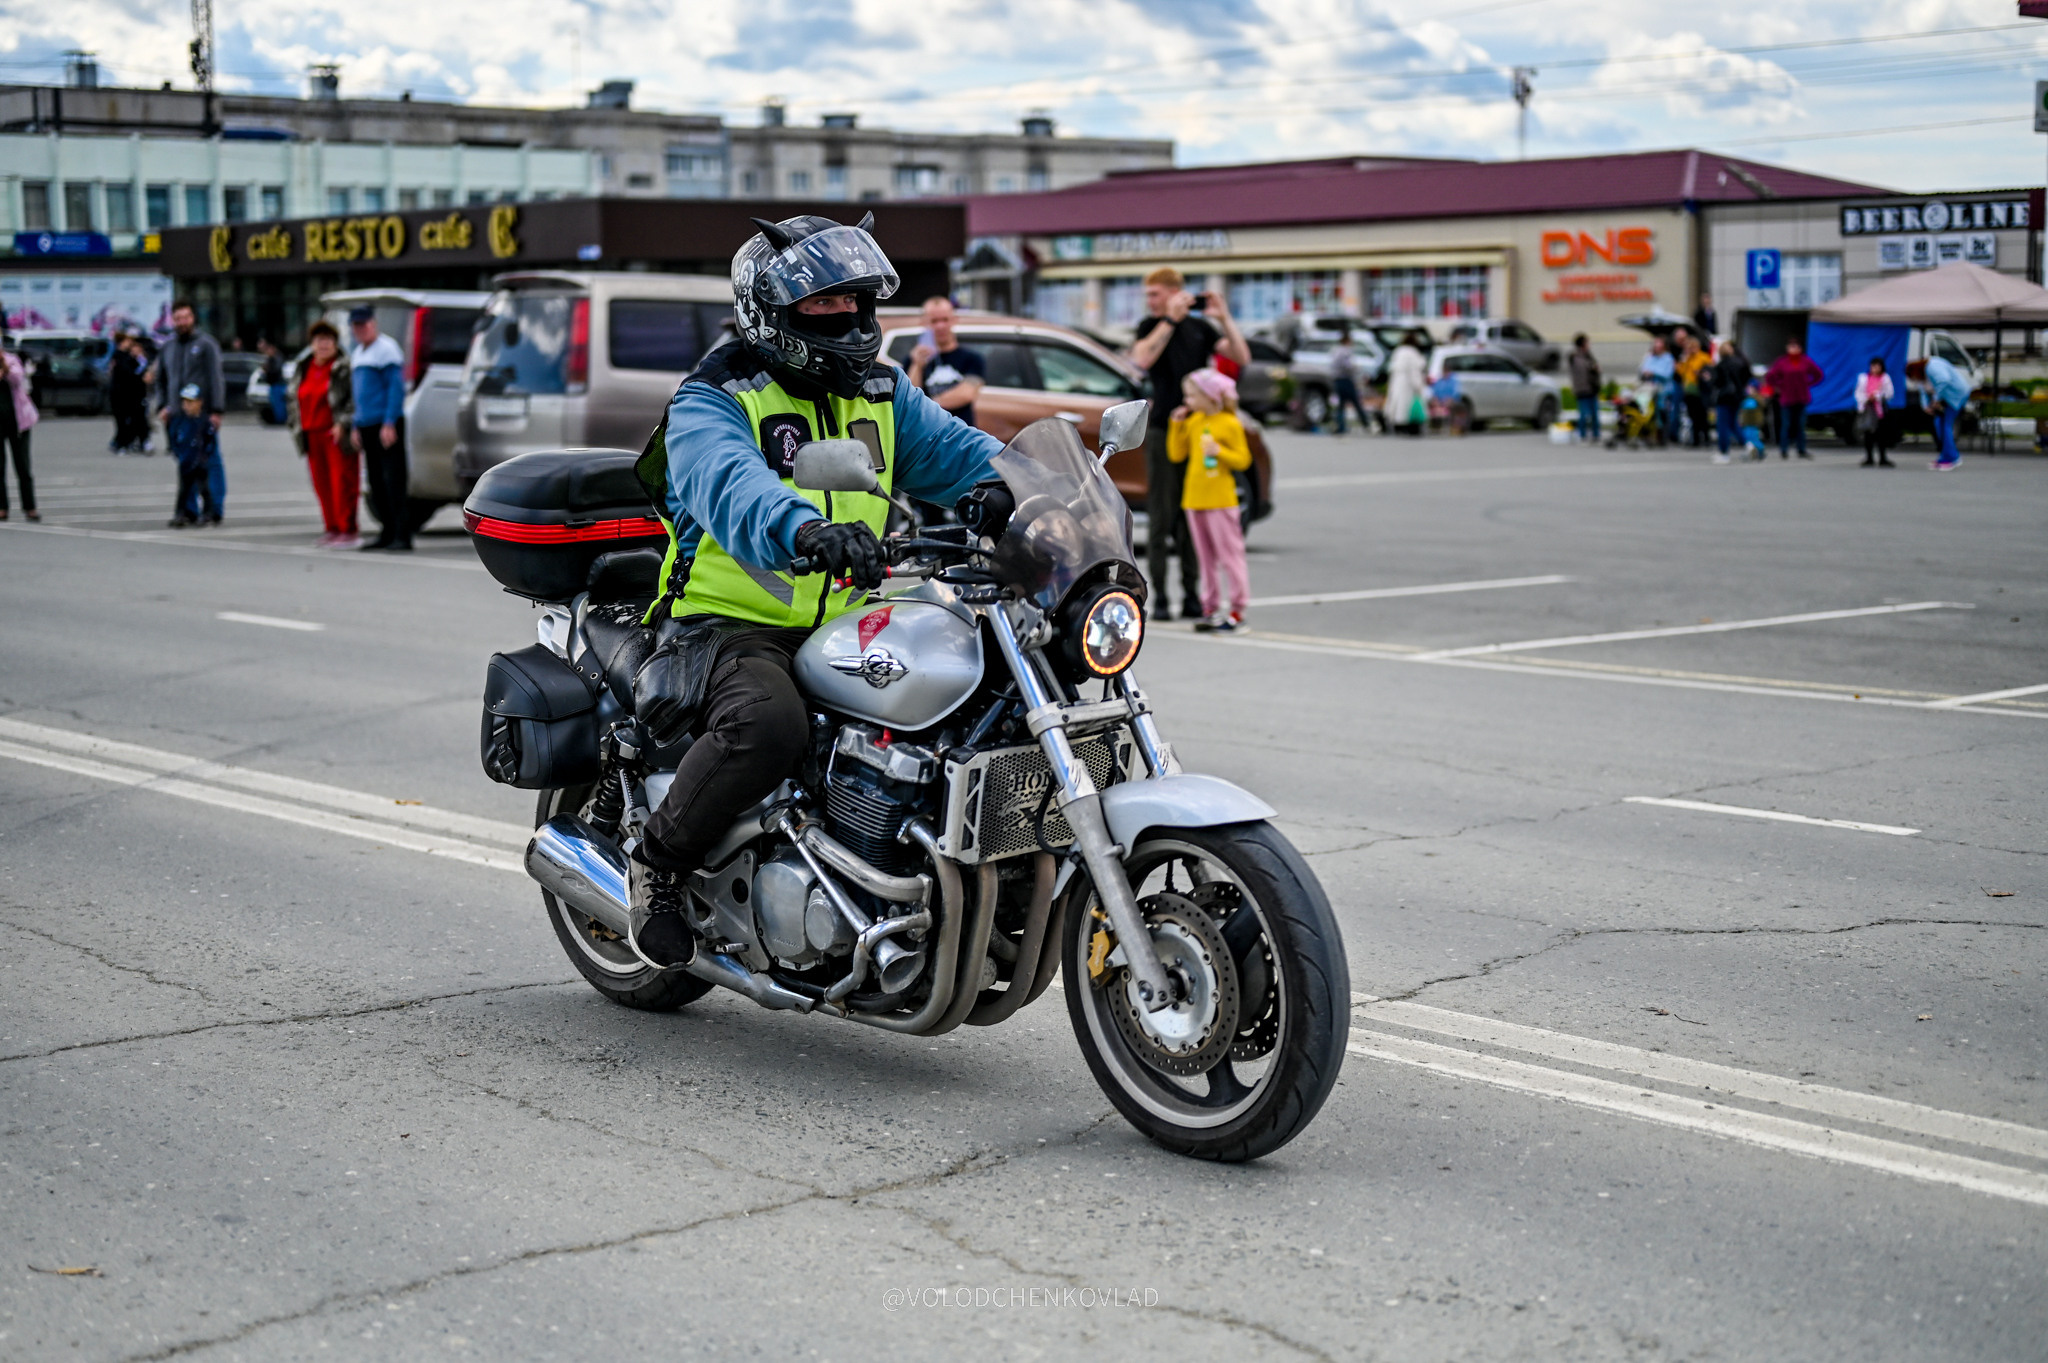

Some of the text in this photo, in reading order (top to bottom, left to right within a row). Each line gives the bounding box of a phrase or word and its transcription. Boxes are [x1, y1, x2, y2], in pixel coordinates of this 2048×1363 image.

[1844, 202, 2030, 233] BEER LINE
[303, 215, 405, 262] RESTO
[1542, 227, 1654, 267] DNS
